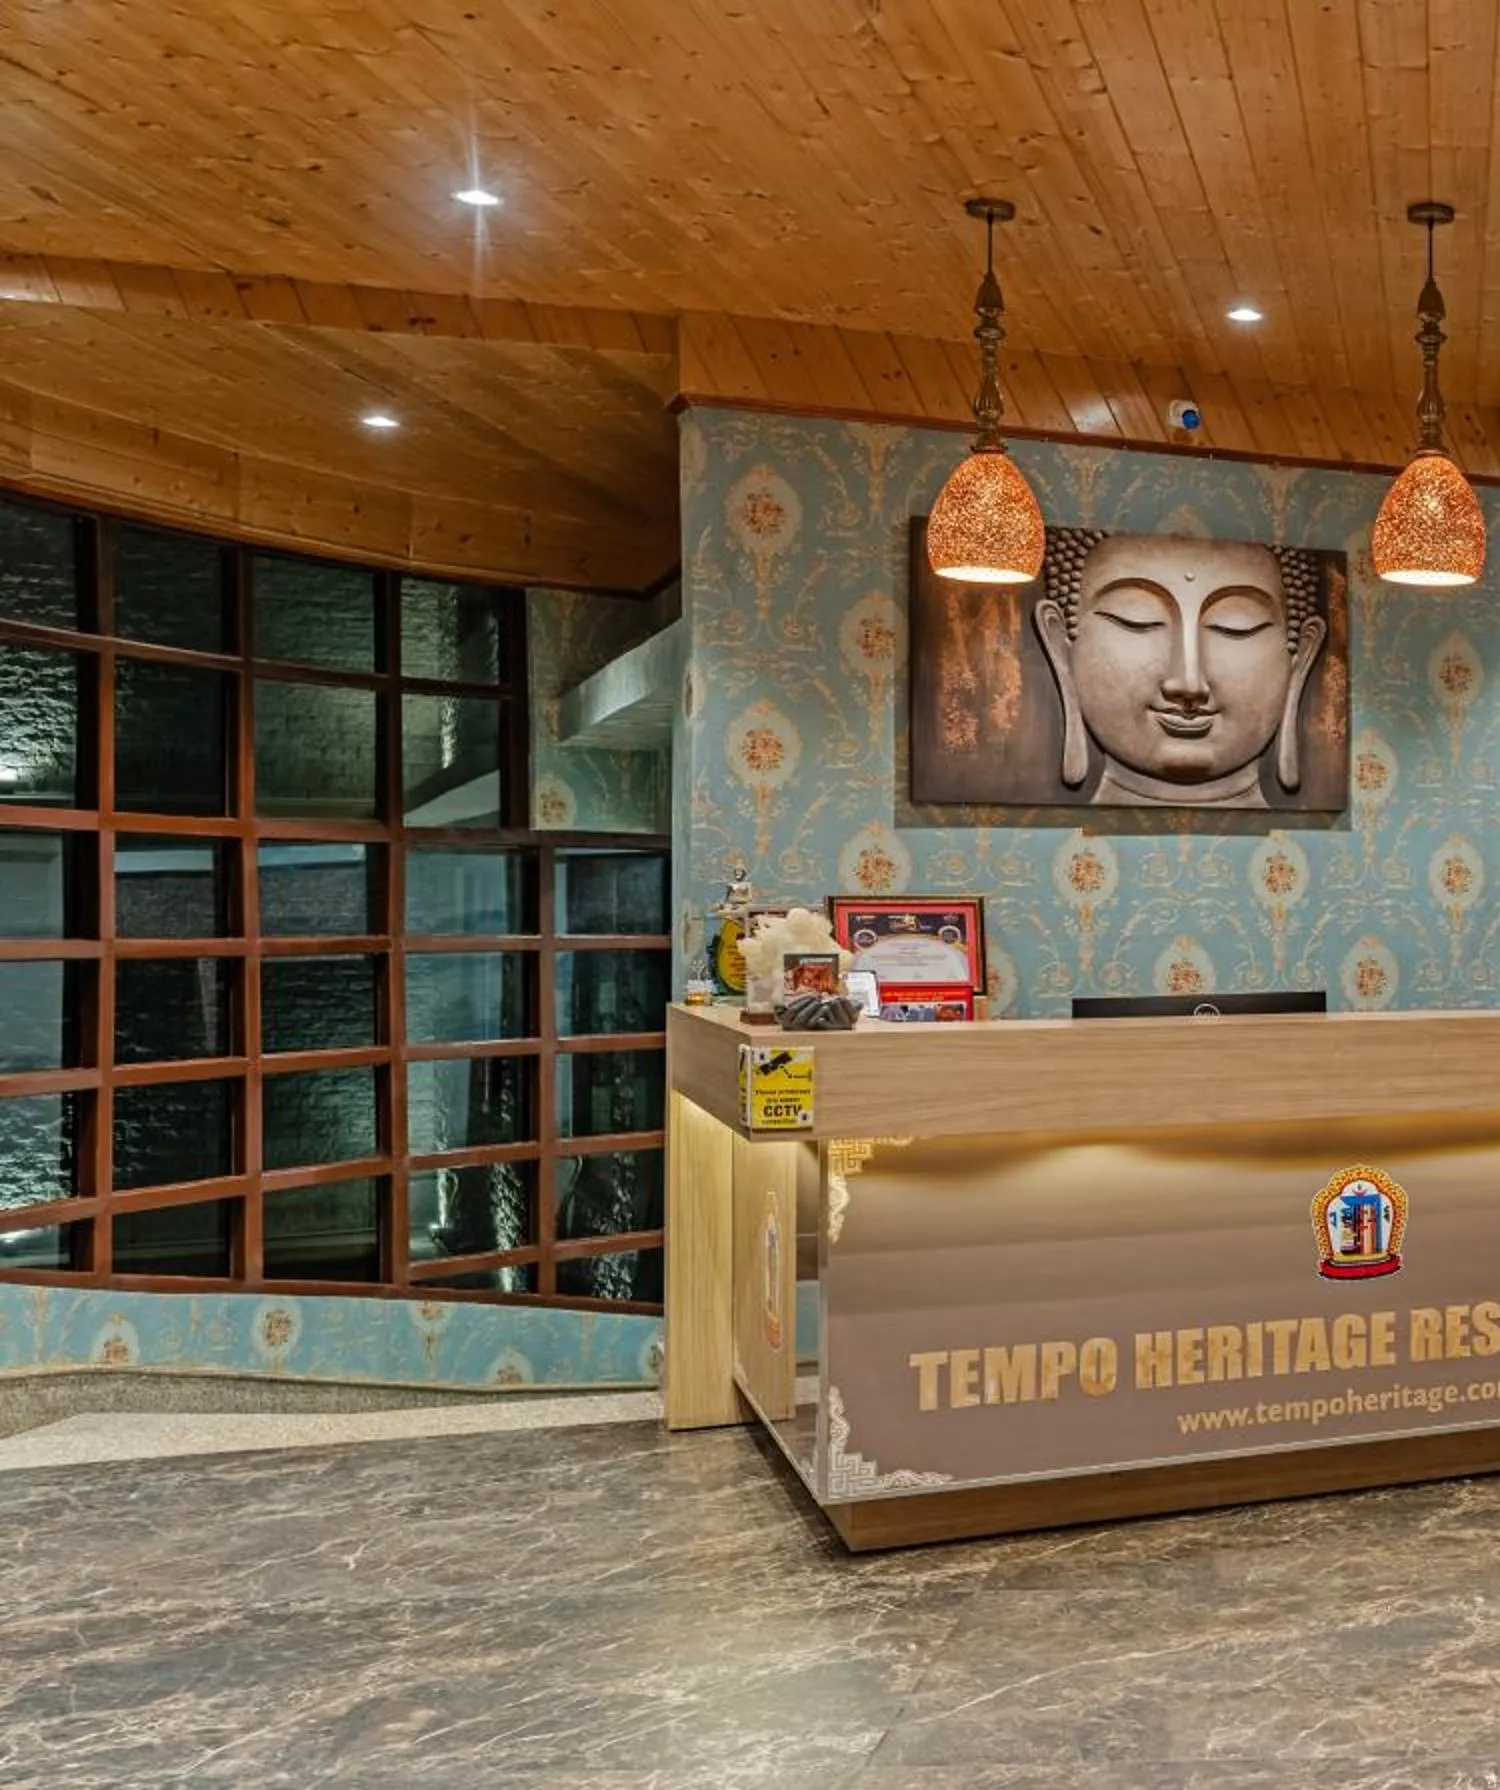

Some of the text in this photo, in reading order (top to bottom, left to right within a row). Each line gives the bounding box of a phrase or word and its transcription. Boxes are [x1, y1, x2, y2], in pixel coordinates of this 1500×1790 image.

[763, 1105, 802, 1117] CCTV
[909, 1337, 1118, 1411] TEMPO
[1135, 1311, 1396, 1390] HERITAGE
